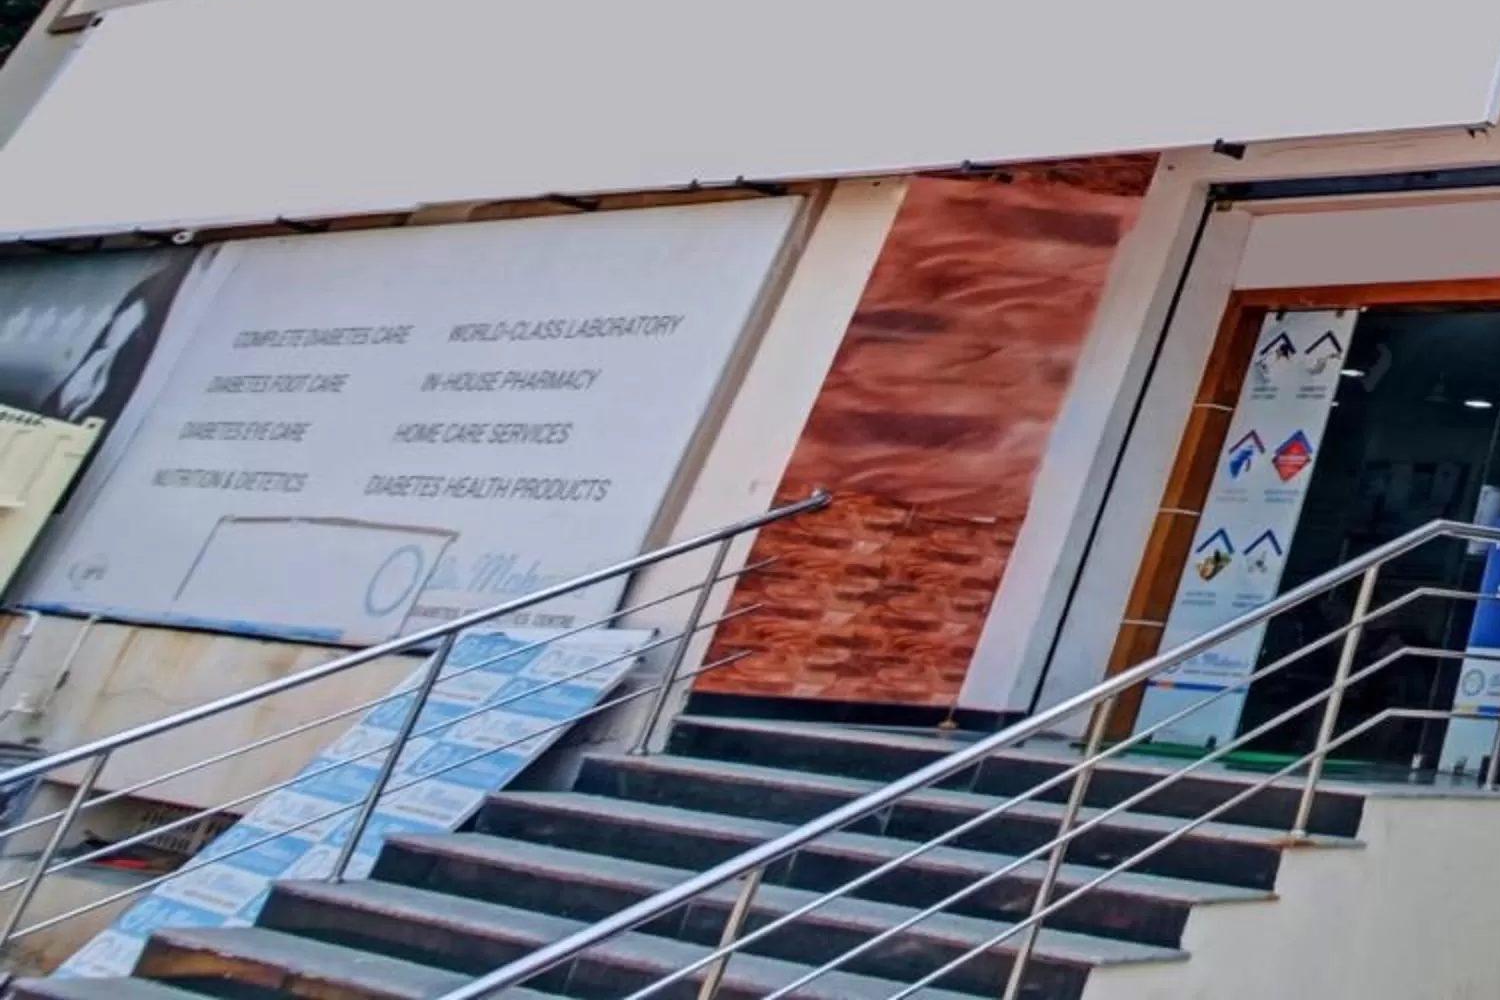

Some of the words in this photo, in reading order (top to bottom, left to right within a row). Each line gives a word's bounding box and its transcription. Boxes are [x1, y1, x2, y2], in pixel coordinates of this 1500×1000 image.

[371, 323, 415, 345] CARE
[565, 314, 685, 338] LABORATORY
[267, 373, 311, 393] FOOT
[306, 372, 350, 393] CARE
[420, 370, 502, 392] IN-HOUSE
[501, 367, 602, 391] PHARMACY
[269, 420, 312, 442] CARE
[393, 422, 444, 444] HOME
[442, 422, 492, 444] CARE
[487, 421, 574, 444] SERVICES
[364, 475, 446, 497] DIABETES
[443, 476, 512, 500] HEALTH
[509, 476, 612, 502] PRODUCTS
